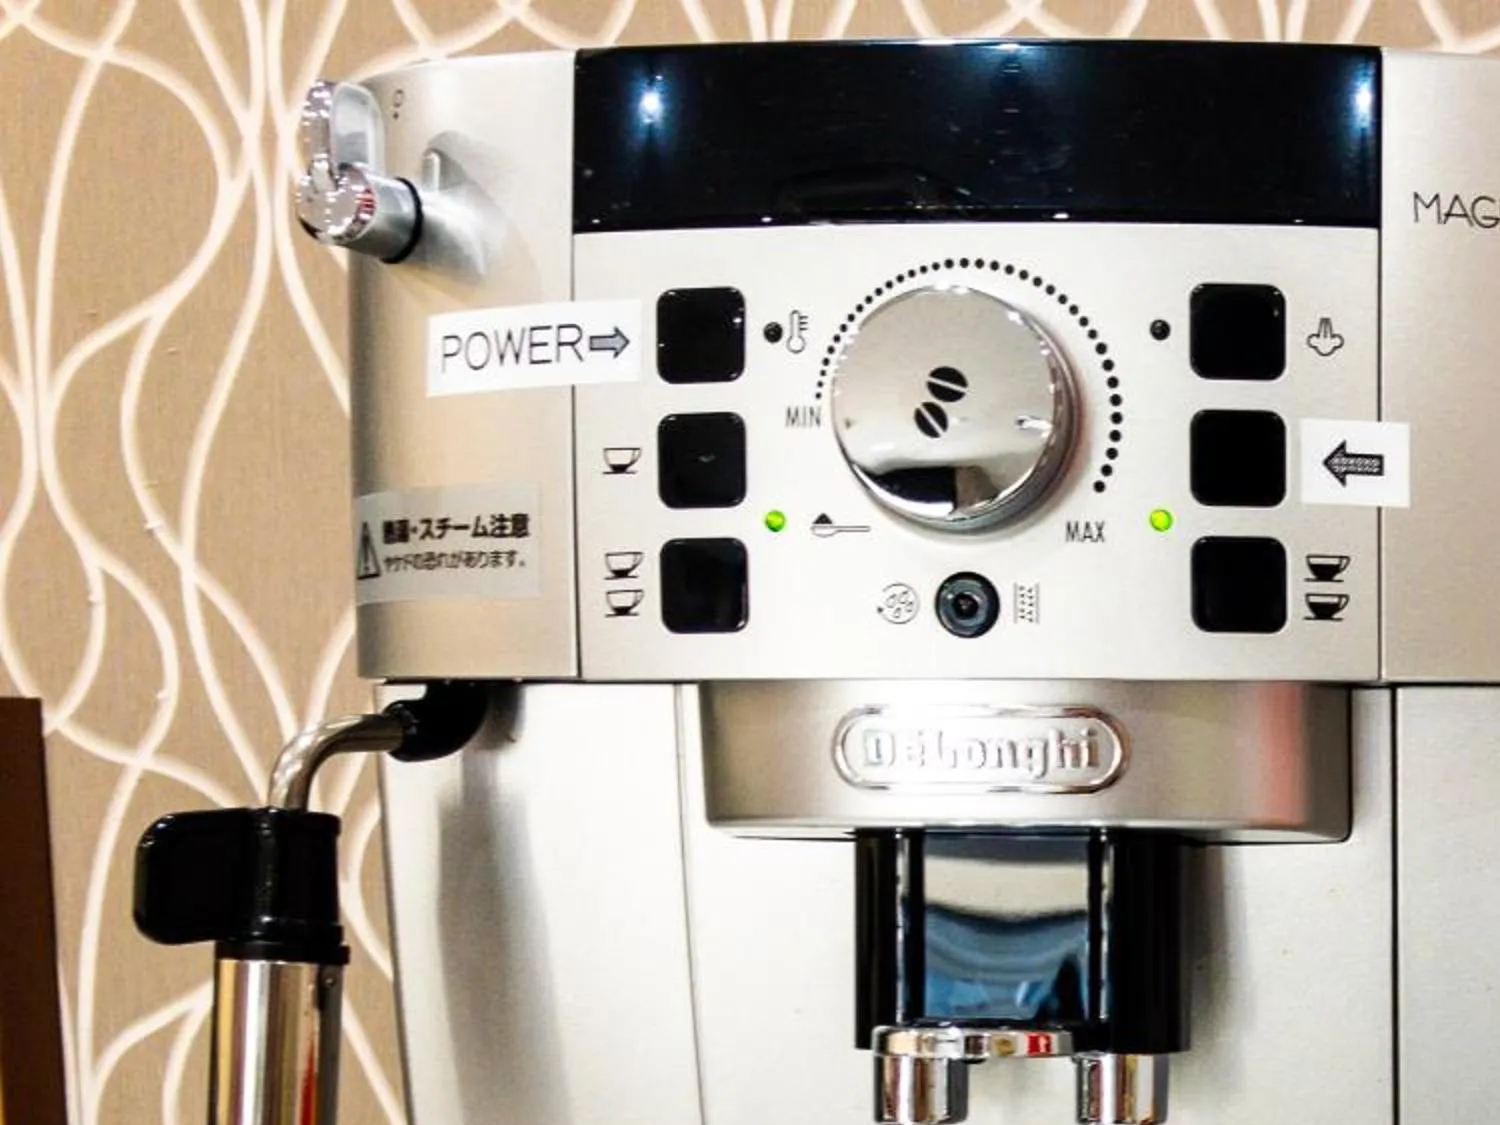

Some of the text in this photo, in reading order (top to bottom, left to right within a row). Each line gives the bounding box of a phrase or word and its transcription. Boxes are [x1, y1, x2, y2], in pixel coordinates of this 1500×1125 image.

[442, 323, 585, 373] POWER
[785, 405, 822, 428] MIN
[1065, 520, 1105, 543] MAX
